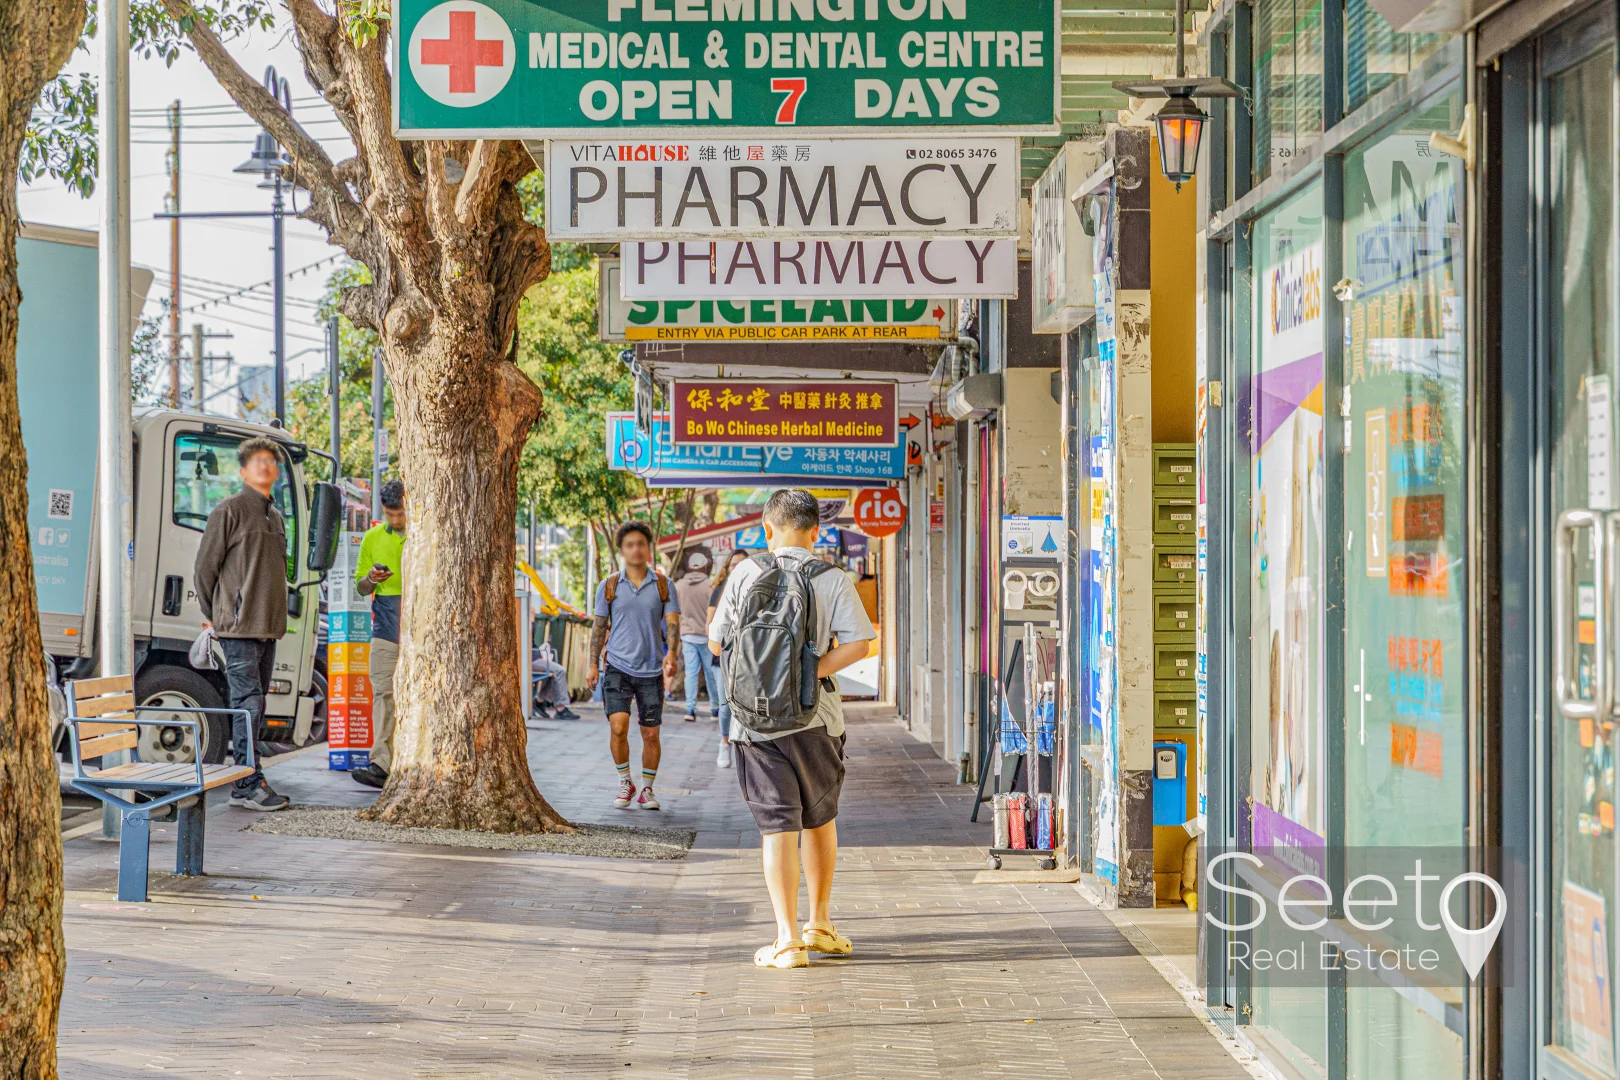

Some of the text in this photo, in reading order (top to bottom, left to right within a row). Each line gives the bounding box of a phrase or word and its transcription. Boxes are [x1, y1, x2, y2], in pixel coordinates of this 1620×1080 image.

[608, 0, 966, 21] FLEMINGTON
[528, 28, 1044, 69] MEDICAL & DENTAL CENTRE
[578, 76, 1000, 125] OPEN 7 DAYS
[918, 148, 997, 159] 02 8065 3476
[569, 162, 998, 228] PHARMACY
[637, 241, 995, 285] PHARMACY
[627, 300, 928, 324] SPICELAND
[657, 327, 907, 339] ENTRY VIA PUBLIC CAR PARK AT REAR
[687, 387, 771, 412] 保和堂
[687, 420, 884, 436] Bo Wo Chinese Herbal Medicine
[804, 448, 840, 462] 자동차
[843, 449, 891, 463] 악세사리
[855, 465, 875, 475] Shop
[860, 491, 902, 519] ria
